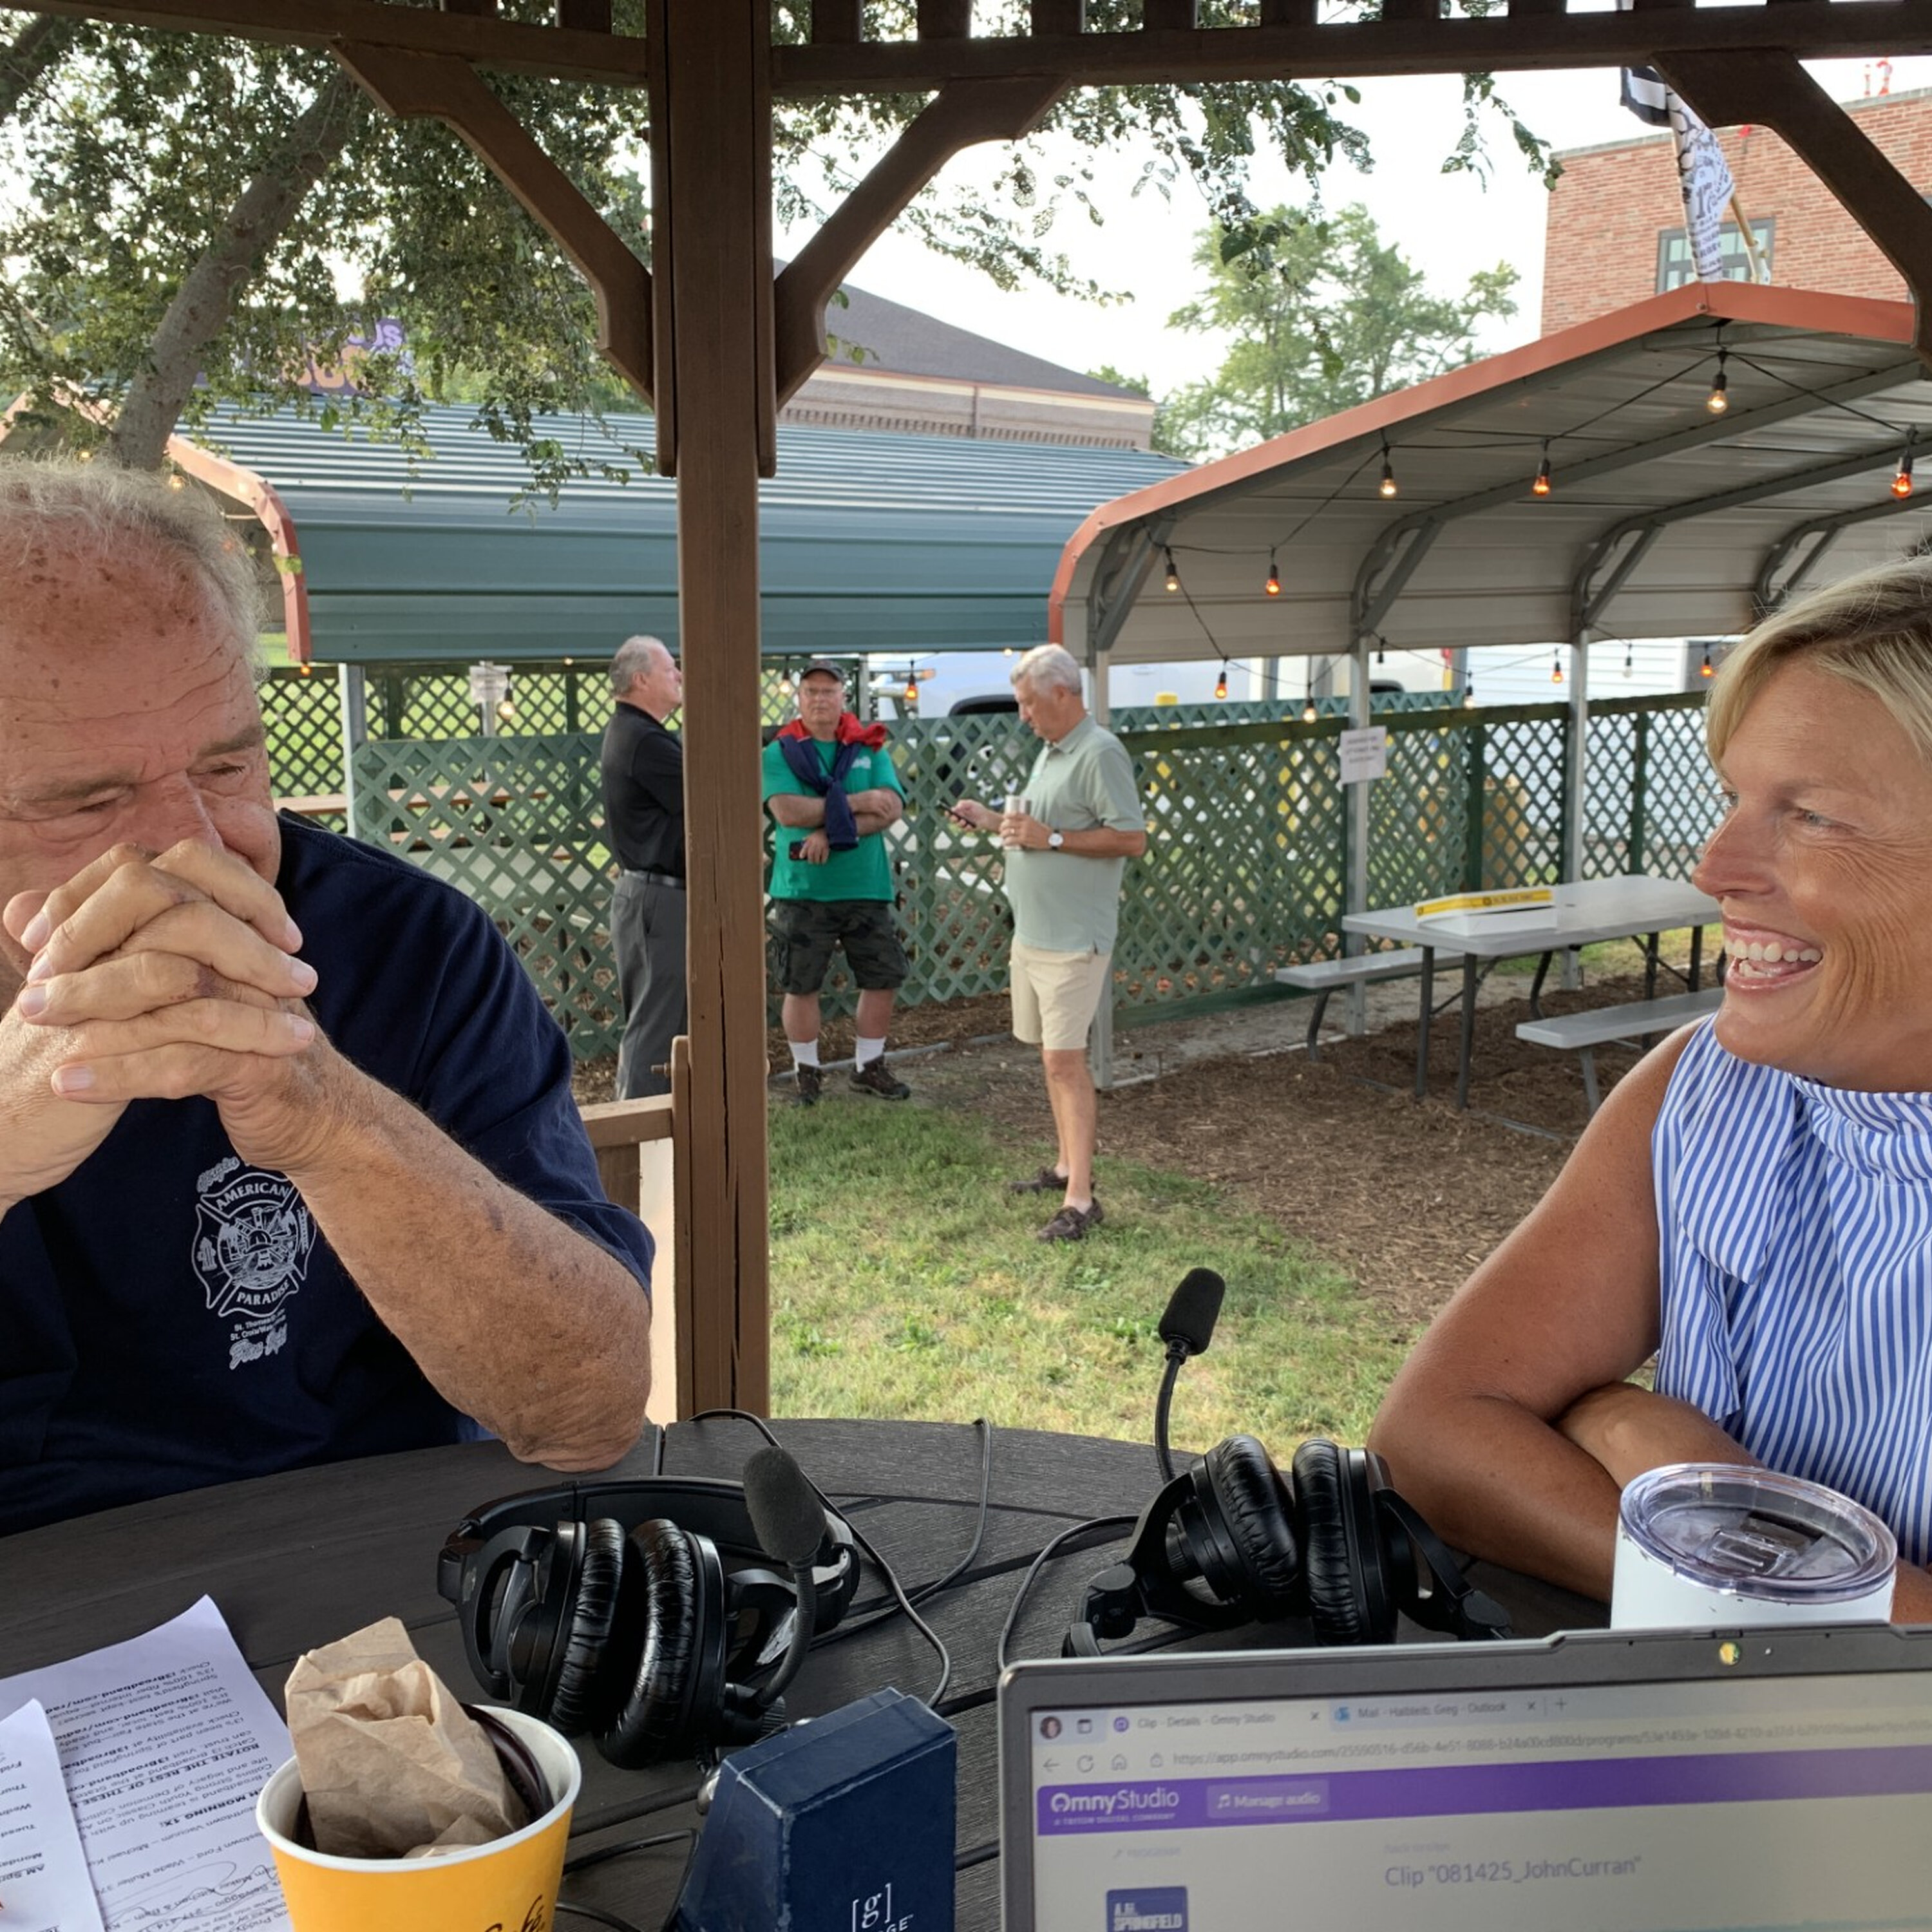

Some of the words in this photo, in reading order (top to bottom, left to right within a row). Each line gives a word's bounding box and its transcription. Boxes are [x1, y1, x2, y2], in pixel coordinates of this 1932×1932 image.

[216, 1182, 289, 1210] AMERICAN
[236, 1280, 289, 1305] PARADISE
[211, 1742, 259, 1762] ROTATE
[183, 1758, 209, 1772] THE
[126, 1780, 144, 1790] OF
[147, 1768, 180, 1783] REST
[81, 1787, 124, 1806] THESE
[1285, 1792, 1321, 1805] audio
[184, 1794, 245, 1820] MORNING
[25, 1864, 46, 1875] AM
[1386, 1866, 1423, 1888] Clip
